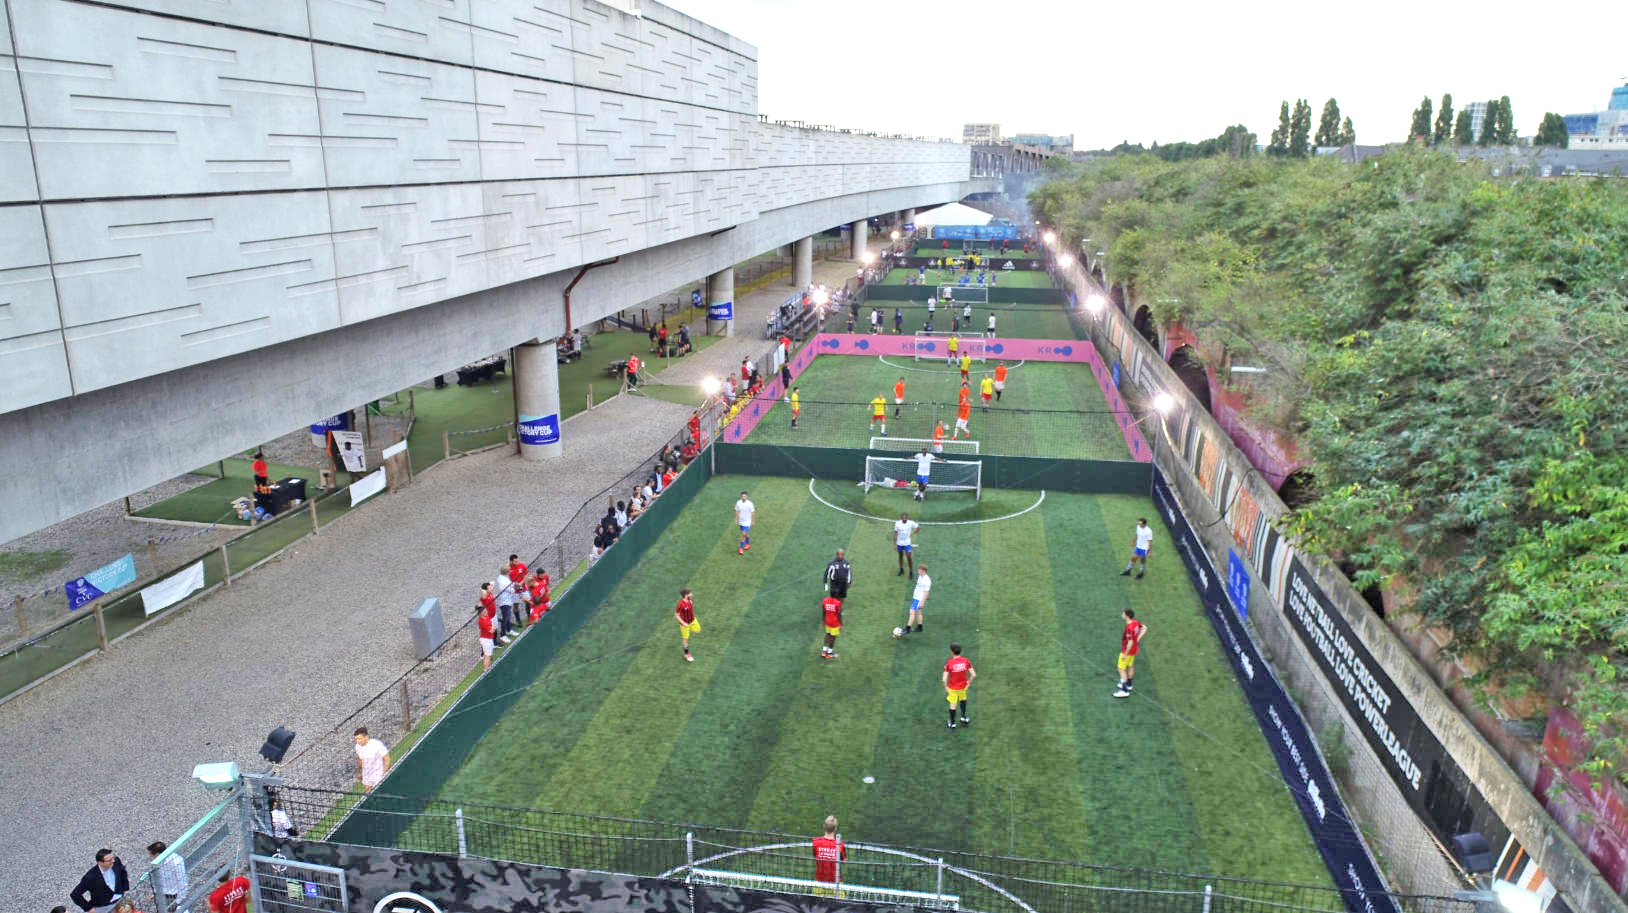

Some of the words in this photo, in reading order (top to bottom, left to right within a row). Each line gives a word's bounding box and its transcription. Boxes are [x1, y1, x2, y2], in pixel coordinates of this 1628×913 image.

[1288, 589, 1305, 622] LOVE
[1303, 611, 1336, 668] FOOTBALL
[1335, 655, 1356, 696] LOVE
[1353, 683, 1422, 791] POWERLEAGUE
[1292, 572, 1309, 603] LOVE
[1306, 592, 1335, 641] NETBALL
[1334, 628, 1355, 667] LOVE
[1353, 657, 1392, 715] CRICKET
